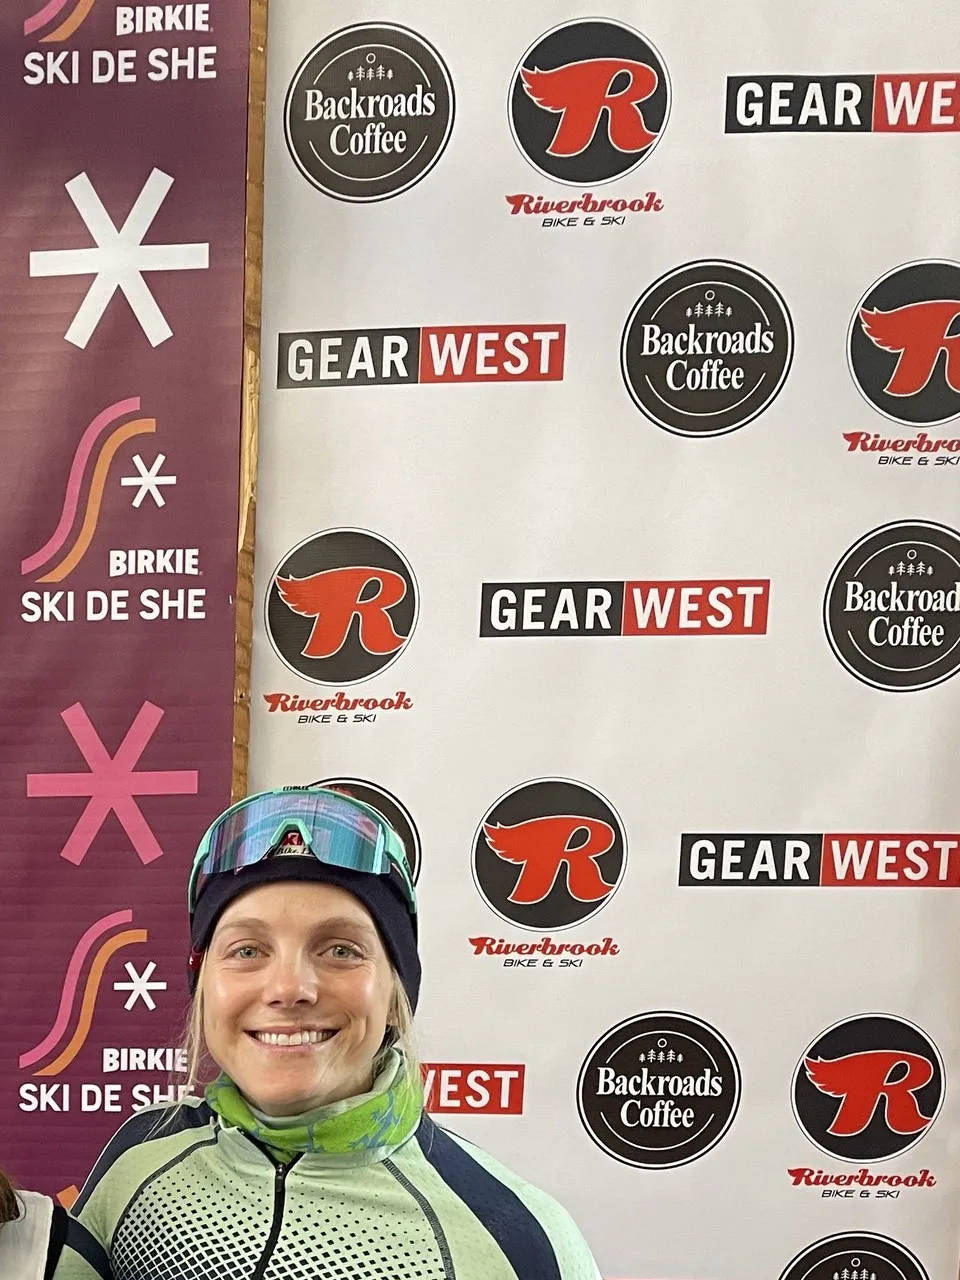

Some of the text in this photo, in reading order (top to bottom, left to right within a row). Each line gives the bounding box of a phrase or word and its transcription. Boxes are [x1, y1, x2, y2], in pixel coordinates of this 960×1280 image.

[116, 3, 210, 36] BIRKIE
[23, 46, 217, 85] SKI DE SHE
[304, 82, 436, 121] Backroads
[735, 80, 960, 127] GEAR WE
[330, 121, 407, 157] Coffee
[506, 192, 664, 216] Riverbrook
[542, 217, 626, 228] BIKE & SKI
[641, 321, 774, 356] Backroads
[286, 332, 558, 382] GEAR WEST
[666, 359, 744, 391] Coffee
[842, 432, 960, 452] Riverbro
[878, 456, 913, 465] BIKE
[109, 548, 199, 577] BIRKIE
[20, 588, 206, 622] SKI DE SHE
[490, 586, 765, 630] GEAR WEST
[843, 581, 960, 612] Backroad
[868, 616, 945, 648] Coffee
[263, 692, 413, 713] Riverbrook
[297, 714, 377, 724] BIKE & SKI
[689, 839, 958, 880] GEAR WEST
[468, 937, 620, 957] Riverbrook
[503, 958, 583, 967] BIKE & SKI
[103, 1048, 188, 1072] BIRKIE
[596, 1066, 723, 1097] Backroads
[19, 1084, 122, 1112] SKI DE
[620, 1100, 695, 1129] Coffee
[787, 1168, 937, 1188] Riverbrook
[821, 1189, 900, 1198] BIKE & SKI
